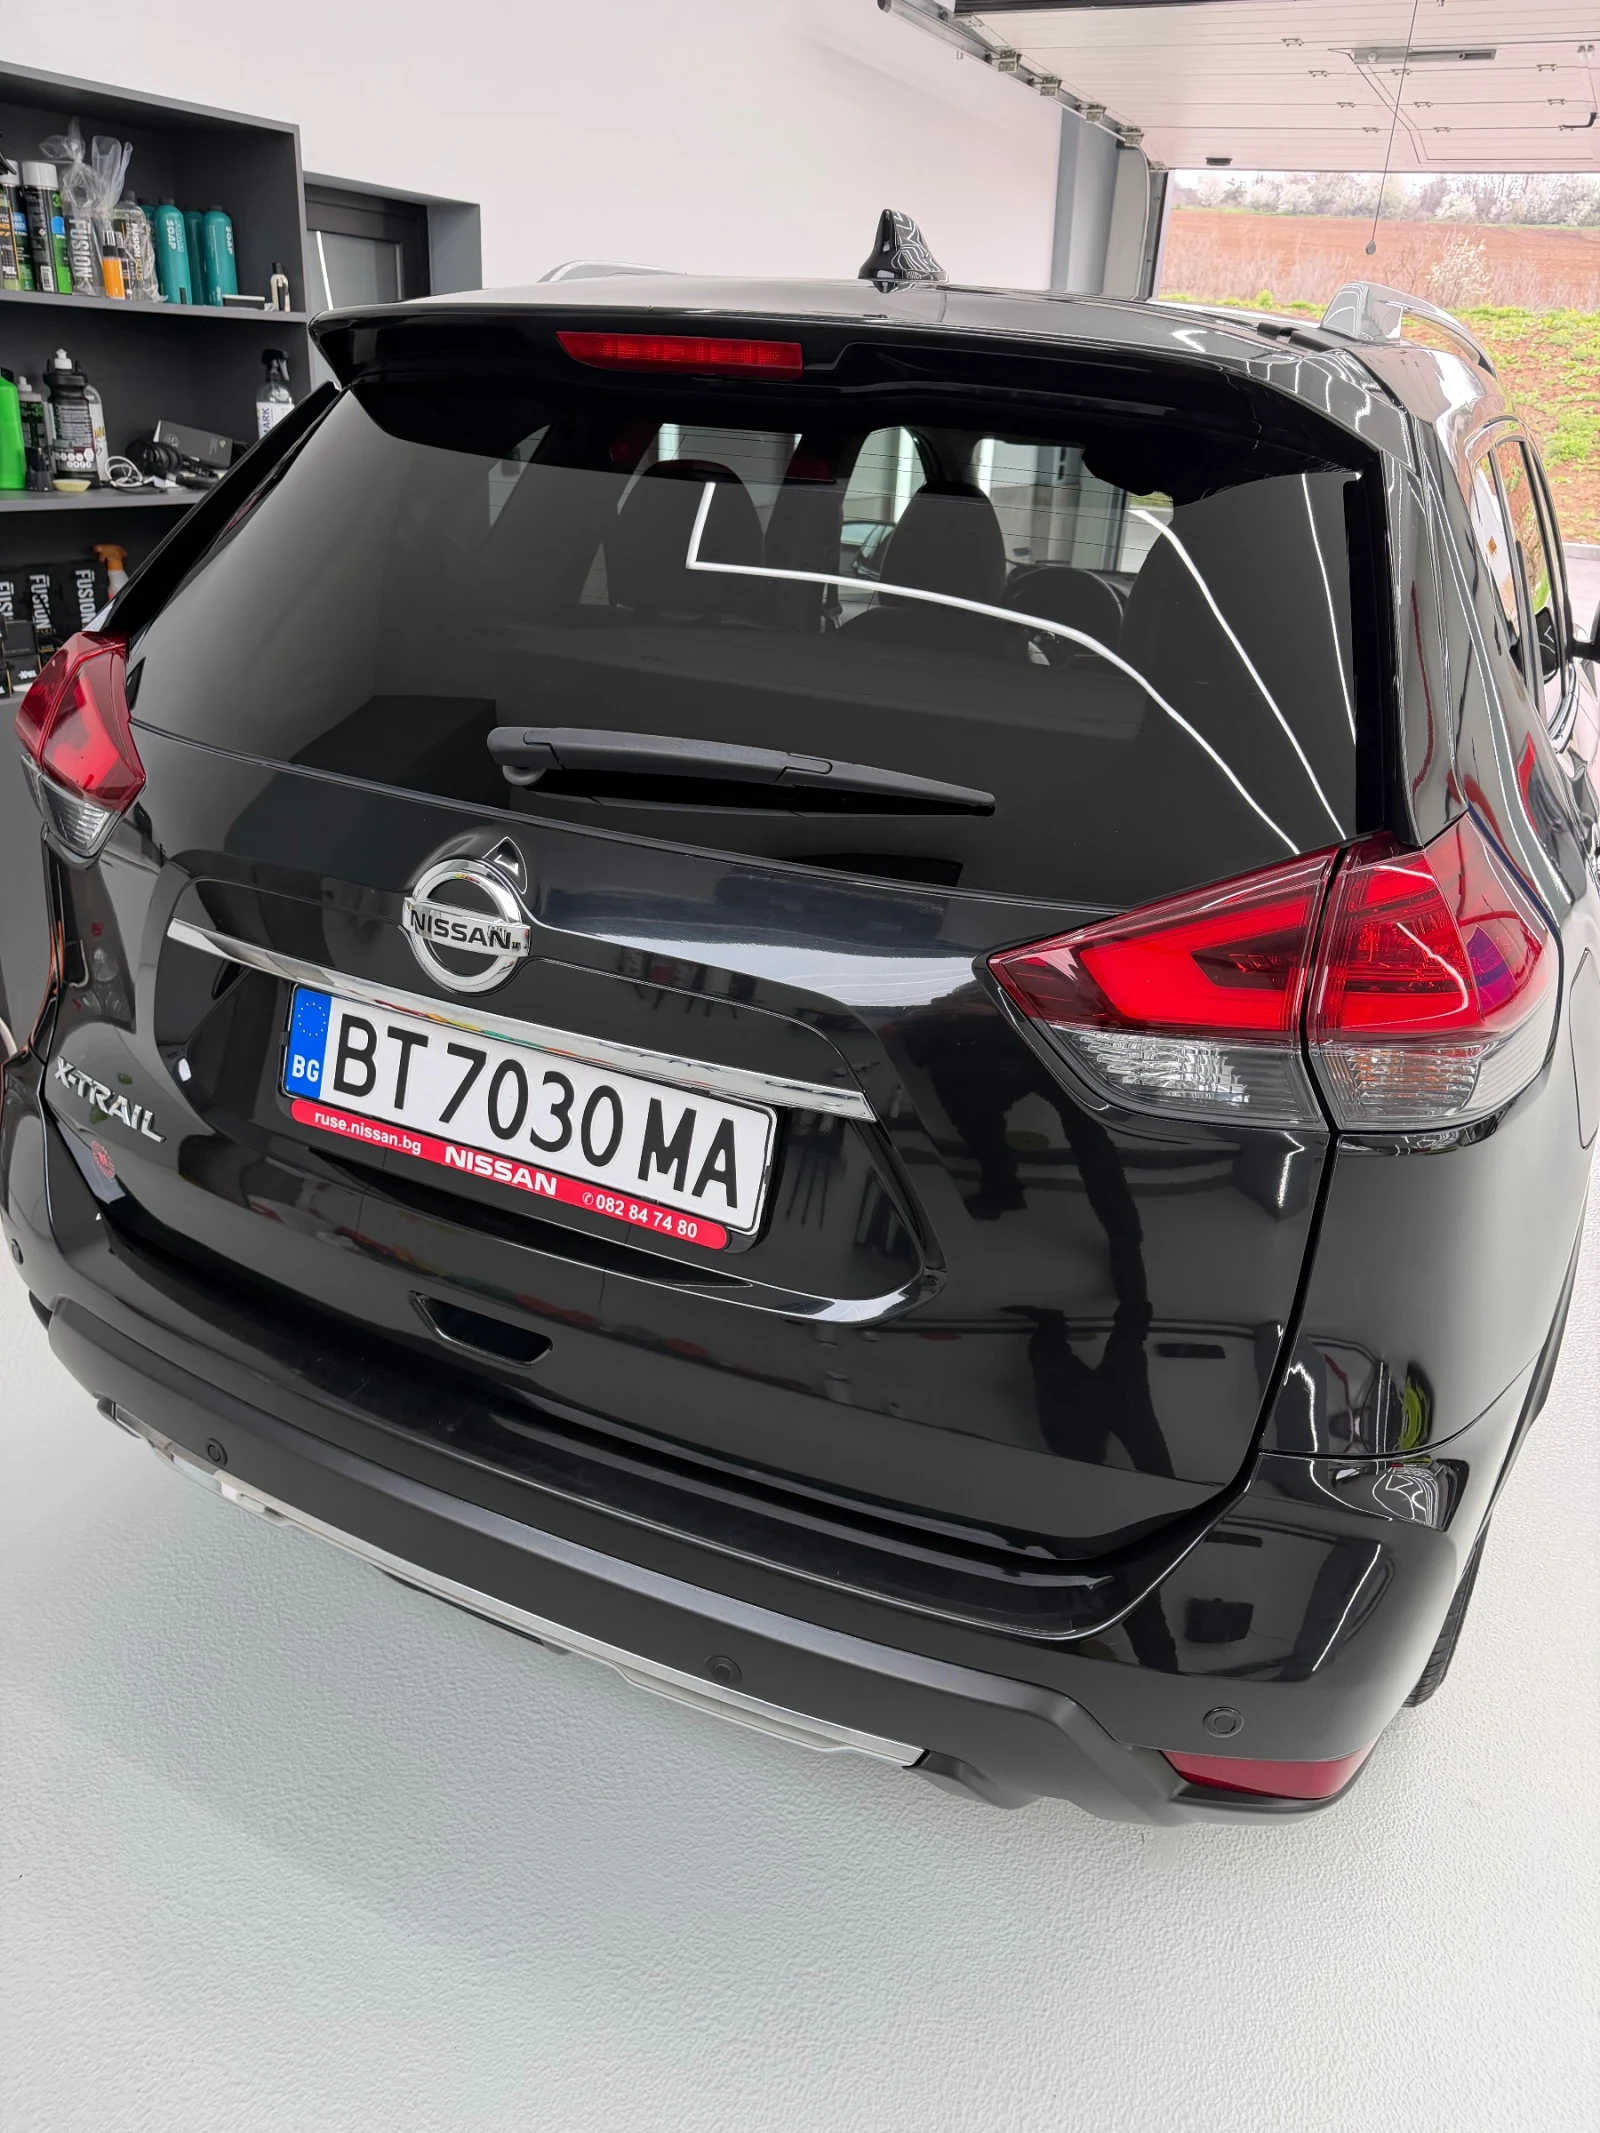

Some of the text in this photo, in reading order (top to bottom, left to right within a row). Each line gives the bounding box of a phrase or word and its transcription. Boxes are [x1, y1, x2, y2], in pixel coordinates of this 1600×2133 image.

[69, 219, 93, 278] FUSION
[166, 219, 177, 250] SOAP
[226, 226, 234, 255] SOAP
[30, 573, 52, 630] FUSION
[75, 569, 97, 627] FUSION
[410, 909, 512, 950] NISSAN
[292, 1054, 320, 1083] BG
[55, 1056, 166, 1143] X-TRAIL
[333, 1012, 739, 1209] BT 7030 MA
[314, 1112, 698, 1238] ruse.nissan.bg NISSAN 082 84 74 80
